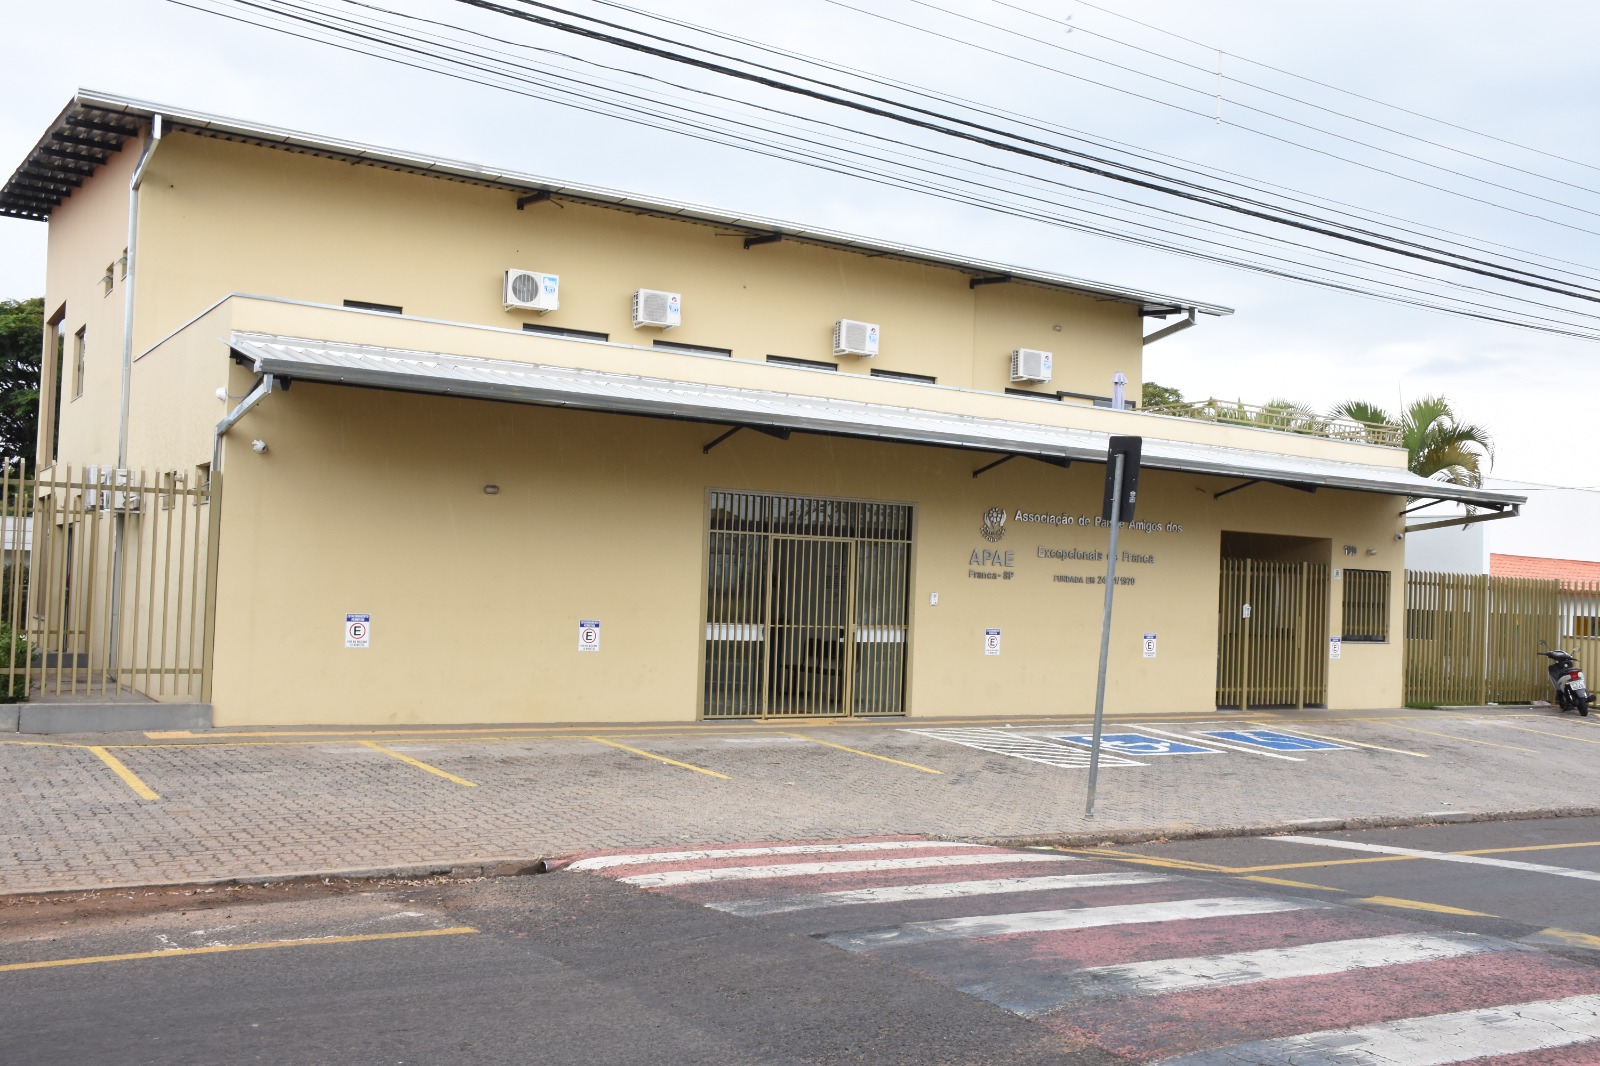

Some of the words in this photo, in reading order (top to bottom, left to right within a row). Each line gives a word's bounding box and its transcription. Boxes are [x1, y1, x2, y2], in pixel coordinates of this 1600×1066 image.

[1015, 510, 1074, 527] Associação
[1078, 515, 1091, 527] de
[1128, 520, 1163, 534] Amigos
[1166, 522, 1183, 533] dos
[969, 548, 1015, 568] APAE
[1037, 546, 1103, 561] Excepcionais
[353, 625, 362, 636] E
[585, 631, 593, 641] E
[990, 637, 996, 647] E
[1147, 641, 1152, 650] E
